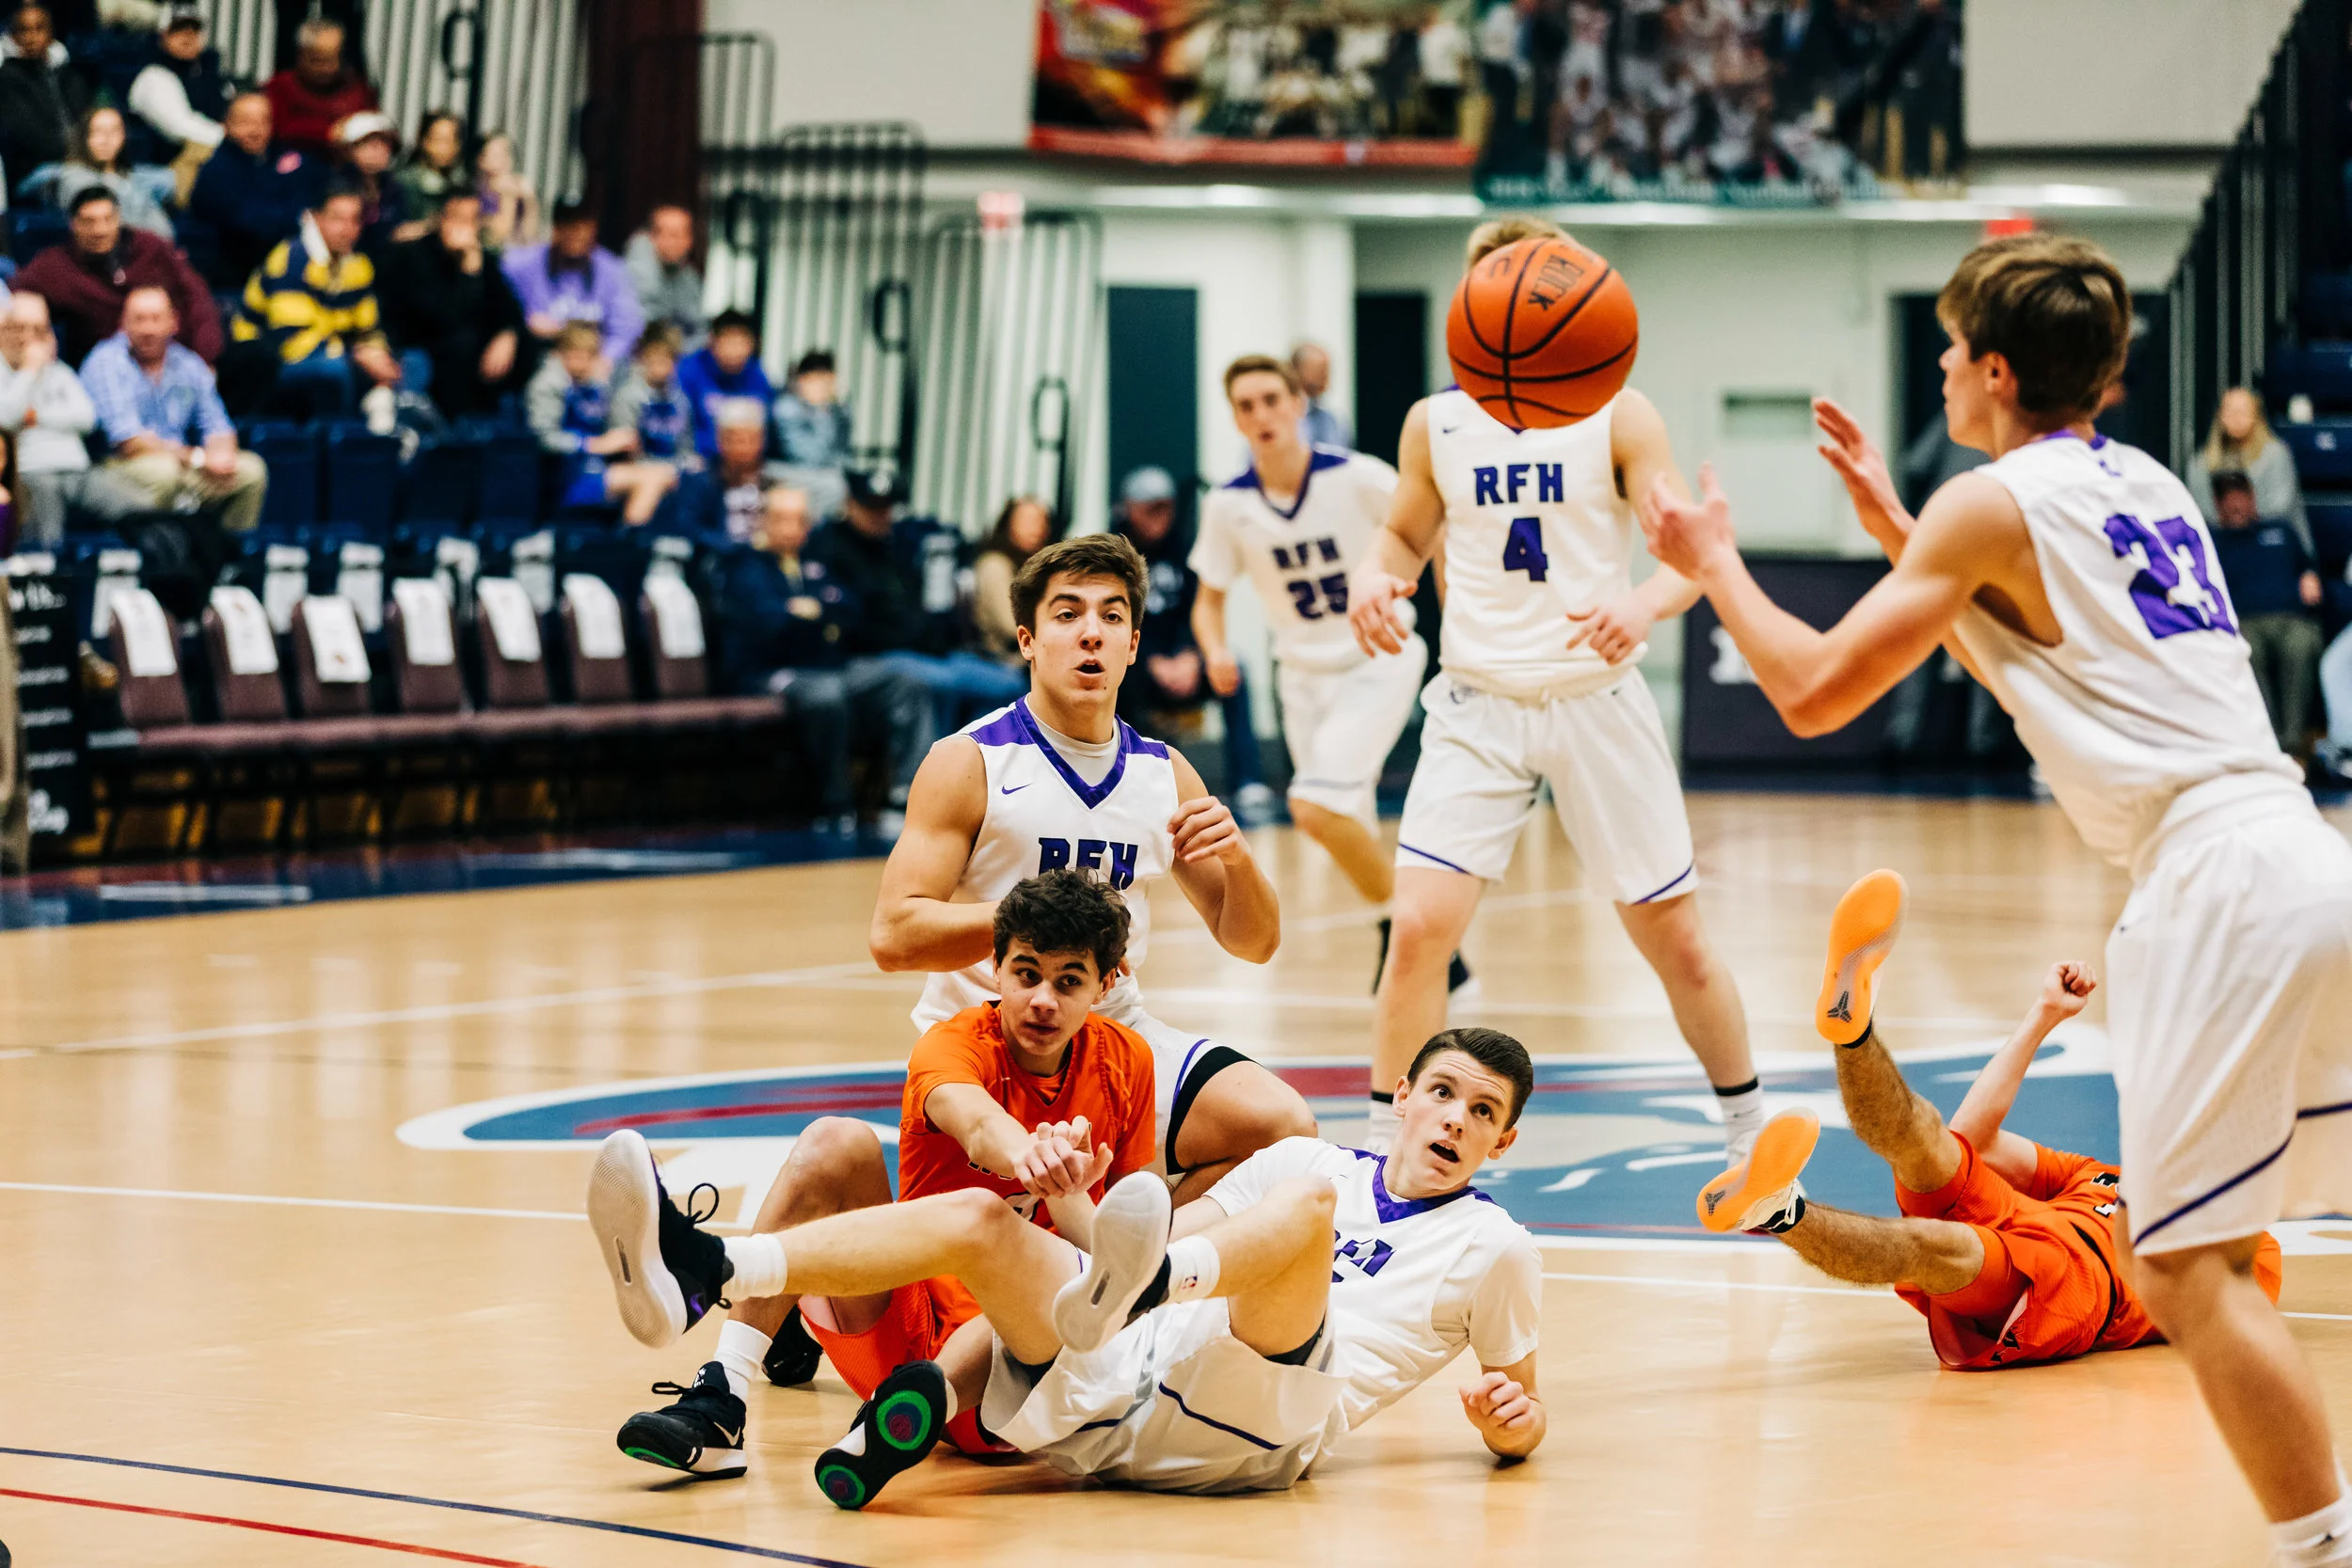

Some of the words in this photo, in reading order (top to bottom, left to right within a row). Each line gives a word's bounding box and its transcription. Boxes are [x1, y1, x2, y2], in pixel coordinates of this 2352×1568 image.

[1528, 253, 1586, 311] ROCK
[1473, 464, 1564, 506] RFH
[1503, 516, 1549, 582] 4
[2103, 514, 2237, 640] 23
[1287, 573, 1348, 621] 25
[1038, 837, 1138, 892] RFH
